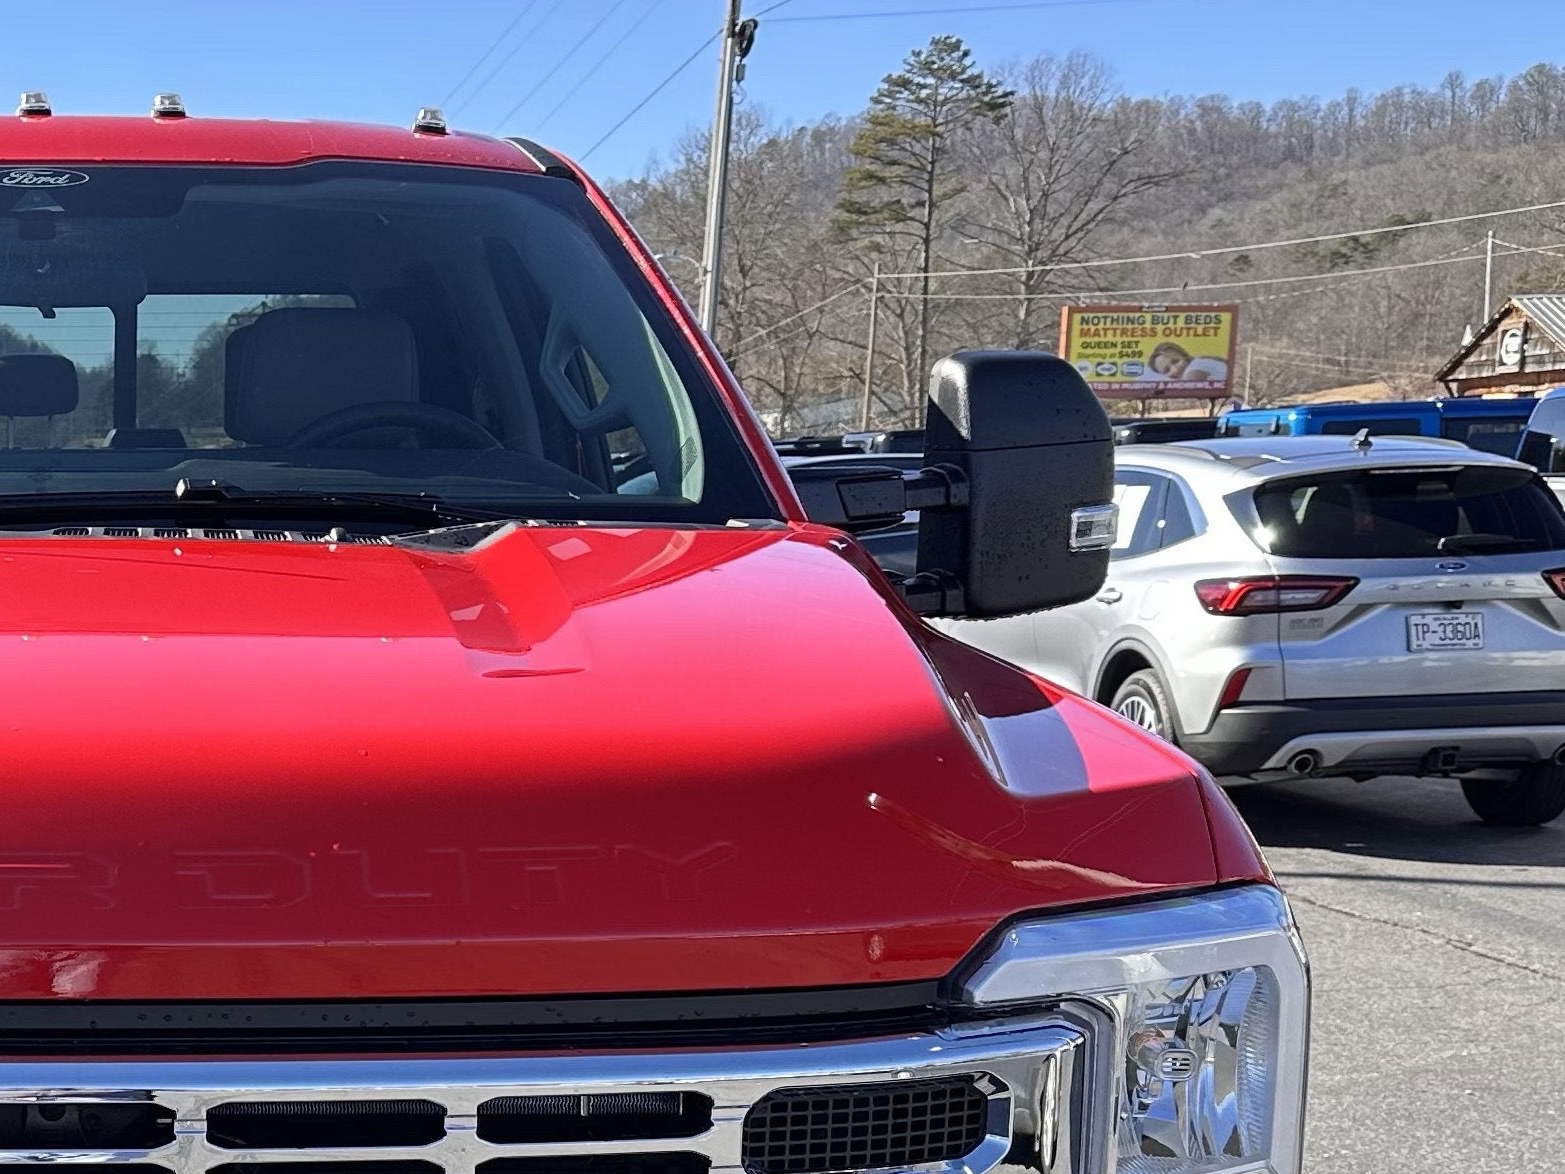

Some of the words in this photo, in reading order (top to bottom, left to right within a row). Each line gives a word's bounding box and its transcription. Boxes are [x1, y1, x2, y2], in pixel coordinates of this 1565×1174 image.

[2, 170, 71, 185] Ford
[1080, 314, 1146, 326] NOTHING
[1151, 314, 1181, 326] BUT
[1184, 314, 1222, 326] BEDS
[1079, 326, 1158, 338] MATTRESS
[1162, 326, 1221, 338] OUTLET
[1080, 340, 1118, 350] QUEEN
[1120, 340, 1141, 349] SET
[1412, 621, 1481, 641] TP-3360A
[172, 841, 739, 909] DUTY
